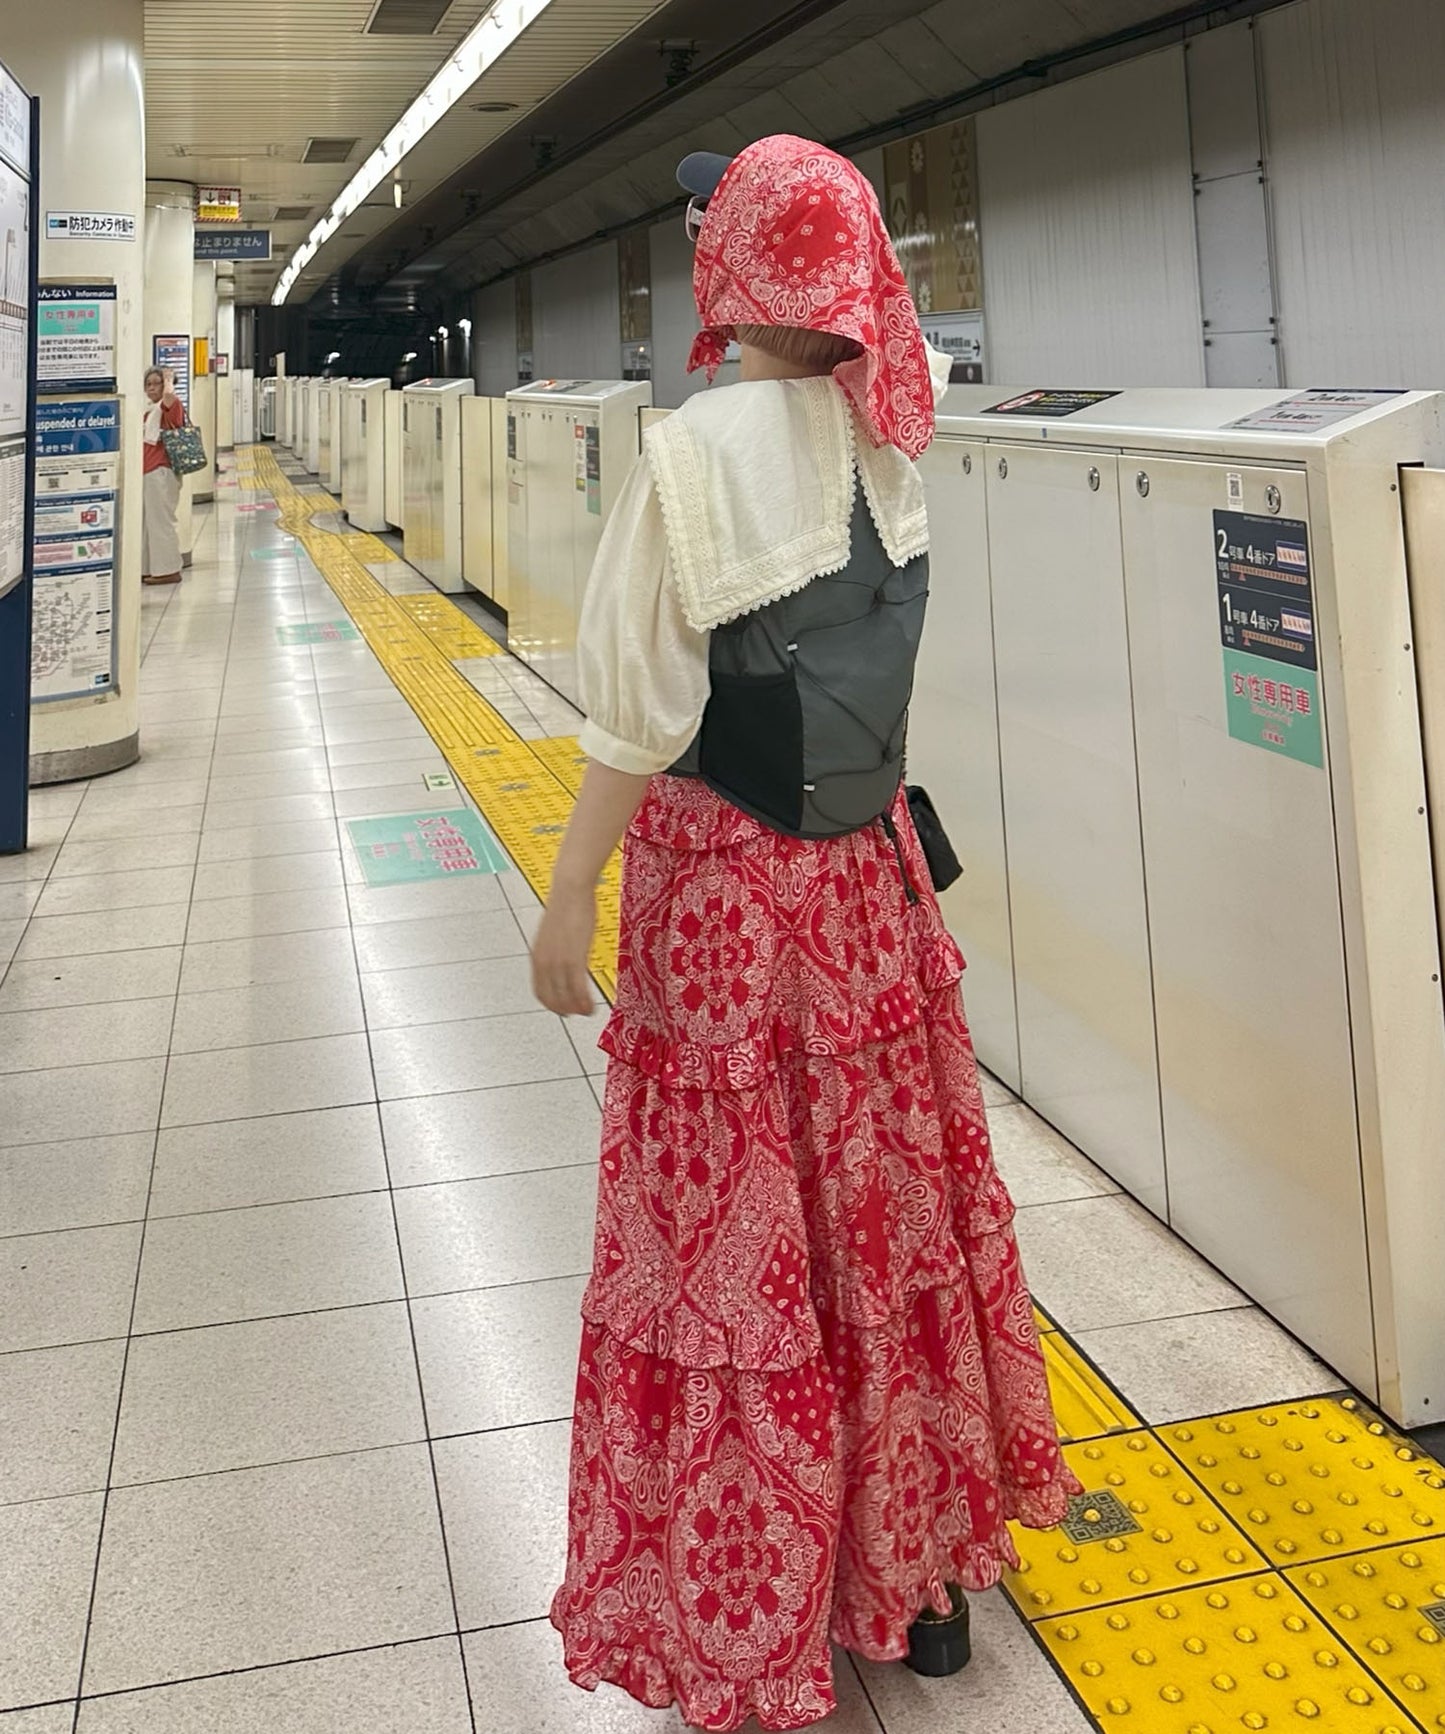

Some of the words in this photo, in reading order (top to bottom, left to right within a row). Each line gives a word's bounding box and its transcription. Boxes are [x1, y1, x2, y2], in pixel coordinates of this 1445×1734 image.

[69, 216, 134, 233] 防犯カメラ作動中
[78, 420, 86, 428] or
[87, 414, 116, 428] delayed
[1217, 528, 1244, 560] 2号車
[1246, 544, 1276, 567] 4番ドア
[1222, 592, 1248, 626] 1号車
[1250, 609, 1280, 633] 4番ドア
[1232, 672, 1311, 715] 女性専用車
